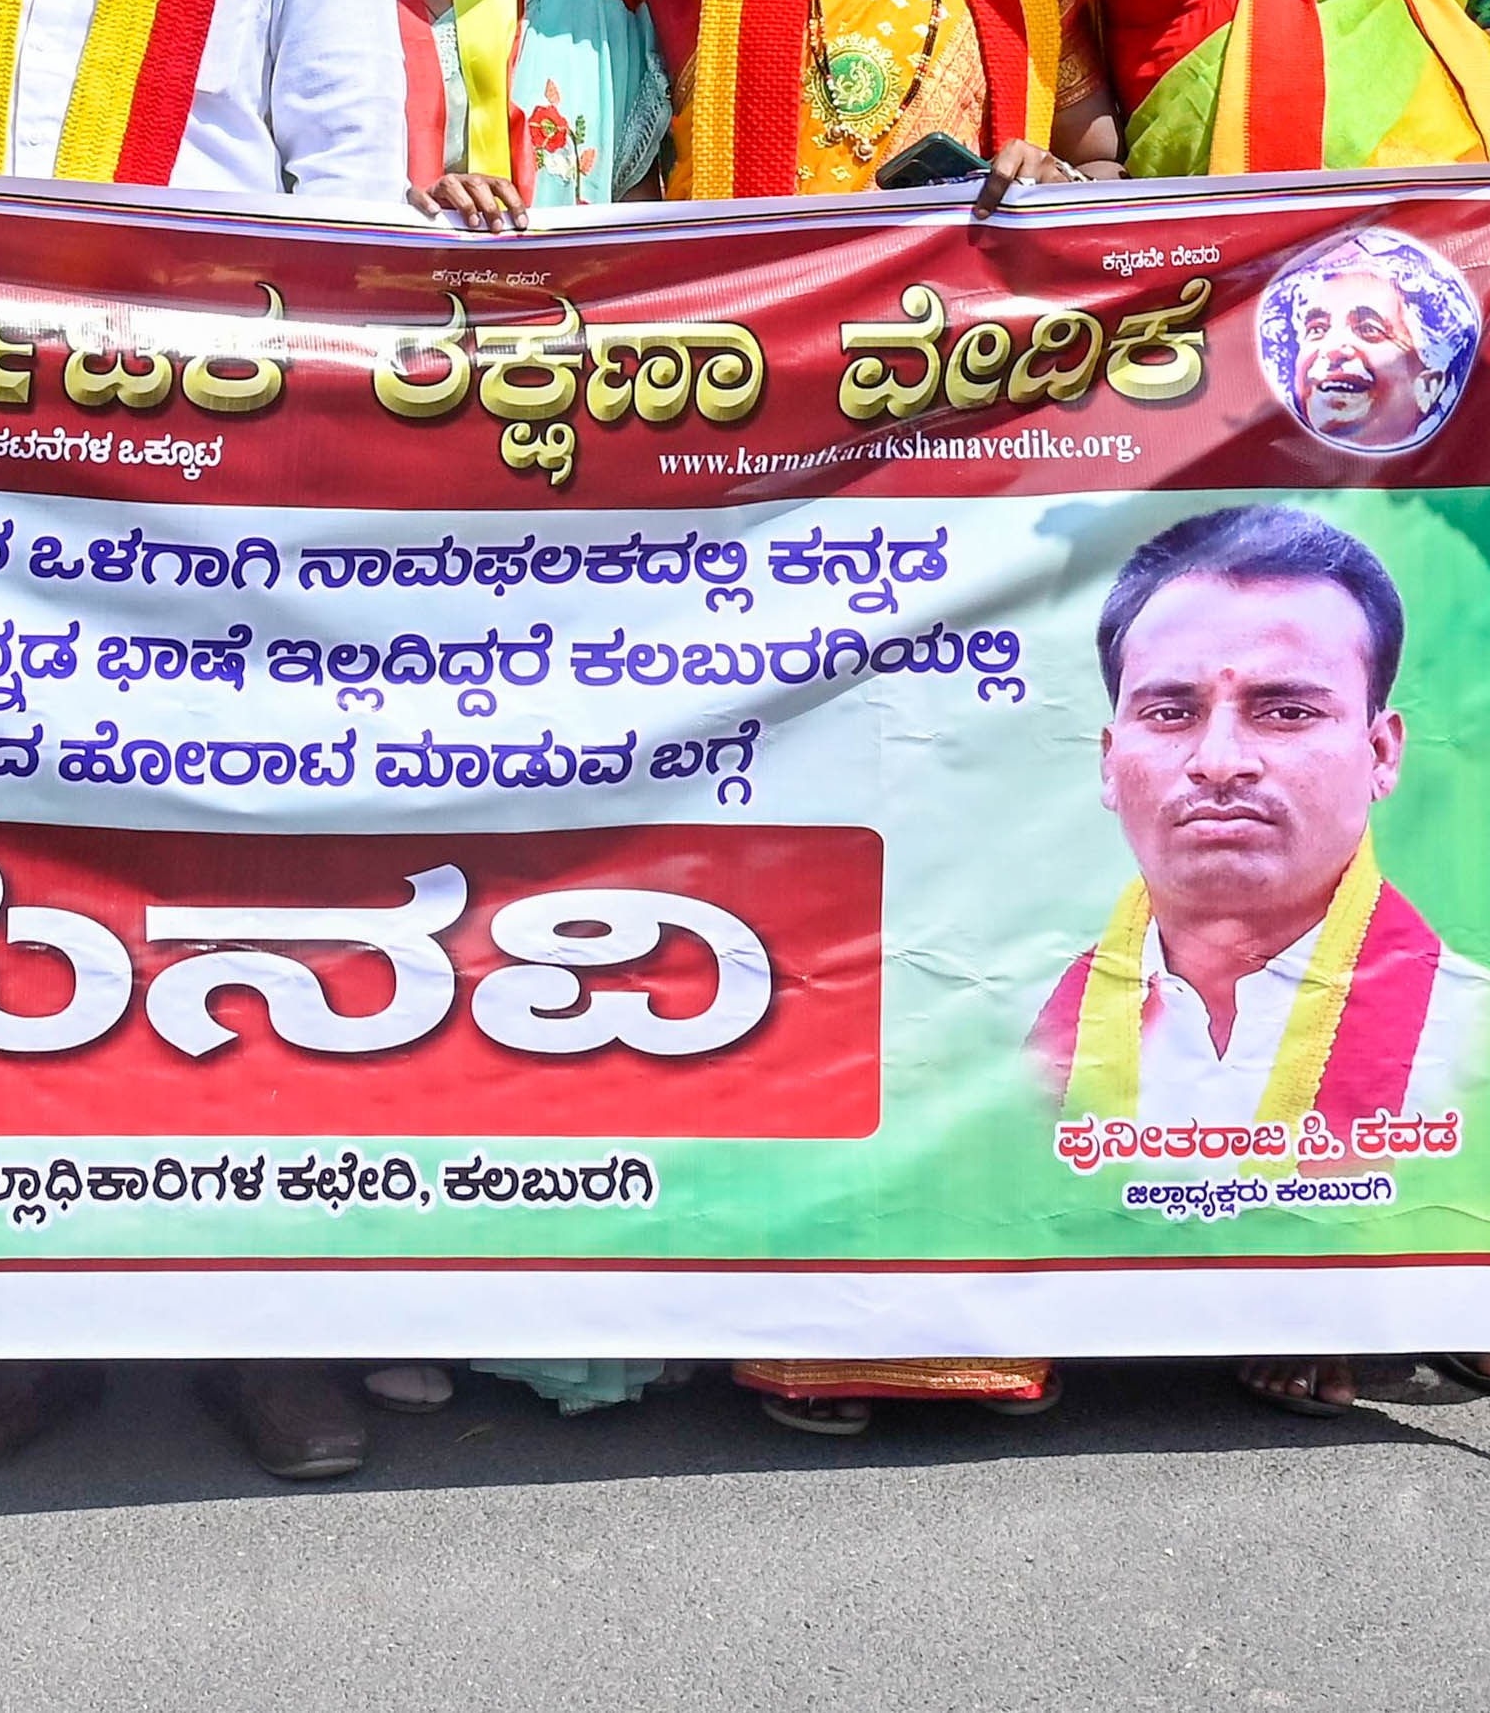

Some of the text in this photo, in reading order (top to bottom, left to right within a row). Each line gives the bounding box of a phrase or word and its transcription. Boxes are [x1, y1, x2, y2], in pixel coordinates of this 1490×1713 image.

[431, 269, 499, 287] ಕನ್ನಡವೇ
[1103, 245, 1221, 277] ಕನ್ನಡವೇ ದೇವರು
[368, 290, 765, 486] ರಕ್ಷಣಾ
[838, 278, 1212, 420] ವೇದಿಕೆ
[118, 434, 222, 480] ಒಕ್ಕೂಟ
[658, 430, 1142, 477] www.karnatkarakshanavedike.org.
[30, 527, 282, 591] ಒಳಗಾಗಿ
[297, 527, 755, 613] ನಾಮಫಲಕದಲ್ಲಿ
[768, 526, 948, 614] ಕನ್ನಡ
[97, 623, 254, 692] ಭಾಷೆ
[267, 624, 552, 717] ಇಲ್ಲದಿದ್ದರೆ
[570, 623, 1026, 700] ಕಲಬುರಗಿಯಲ್ಲಿ
[58, 719, 356, 788] ಹೋರಾಟ
[375, 726, 637, 788] ಮಾಡುವ
[650, 719, 762, 805] ಬಗ್ಗೆ
[1058, 1111, 1459, 1169] ಪುನೀತರಾಜ ಸಿ. ಕವಡೆ
[277, 1153, 430, 1211] ಕಛೇರಿ,
[444, 1155, 652, 1203] ಕಲಬುರಗಿ
[1127, 1176, 1394, 1218] ಜಿಲ್ಲಾಧ್ಯಕ್ಷರು ಕಲಬುರಗಿ
